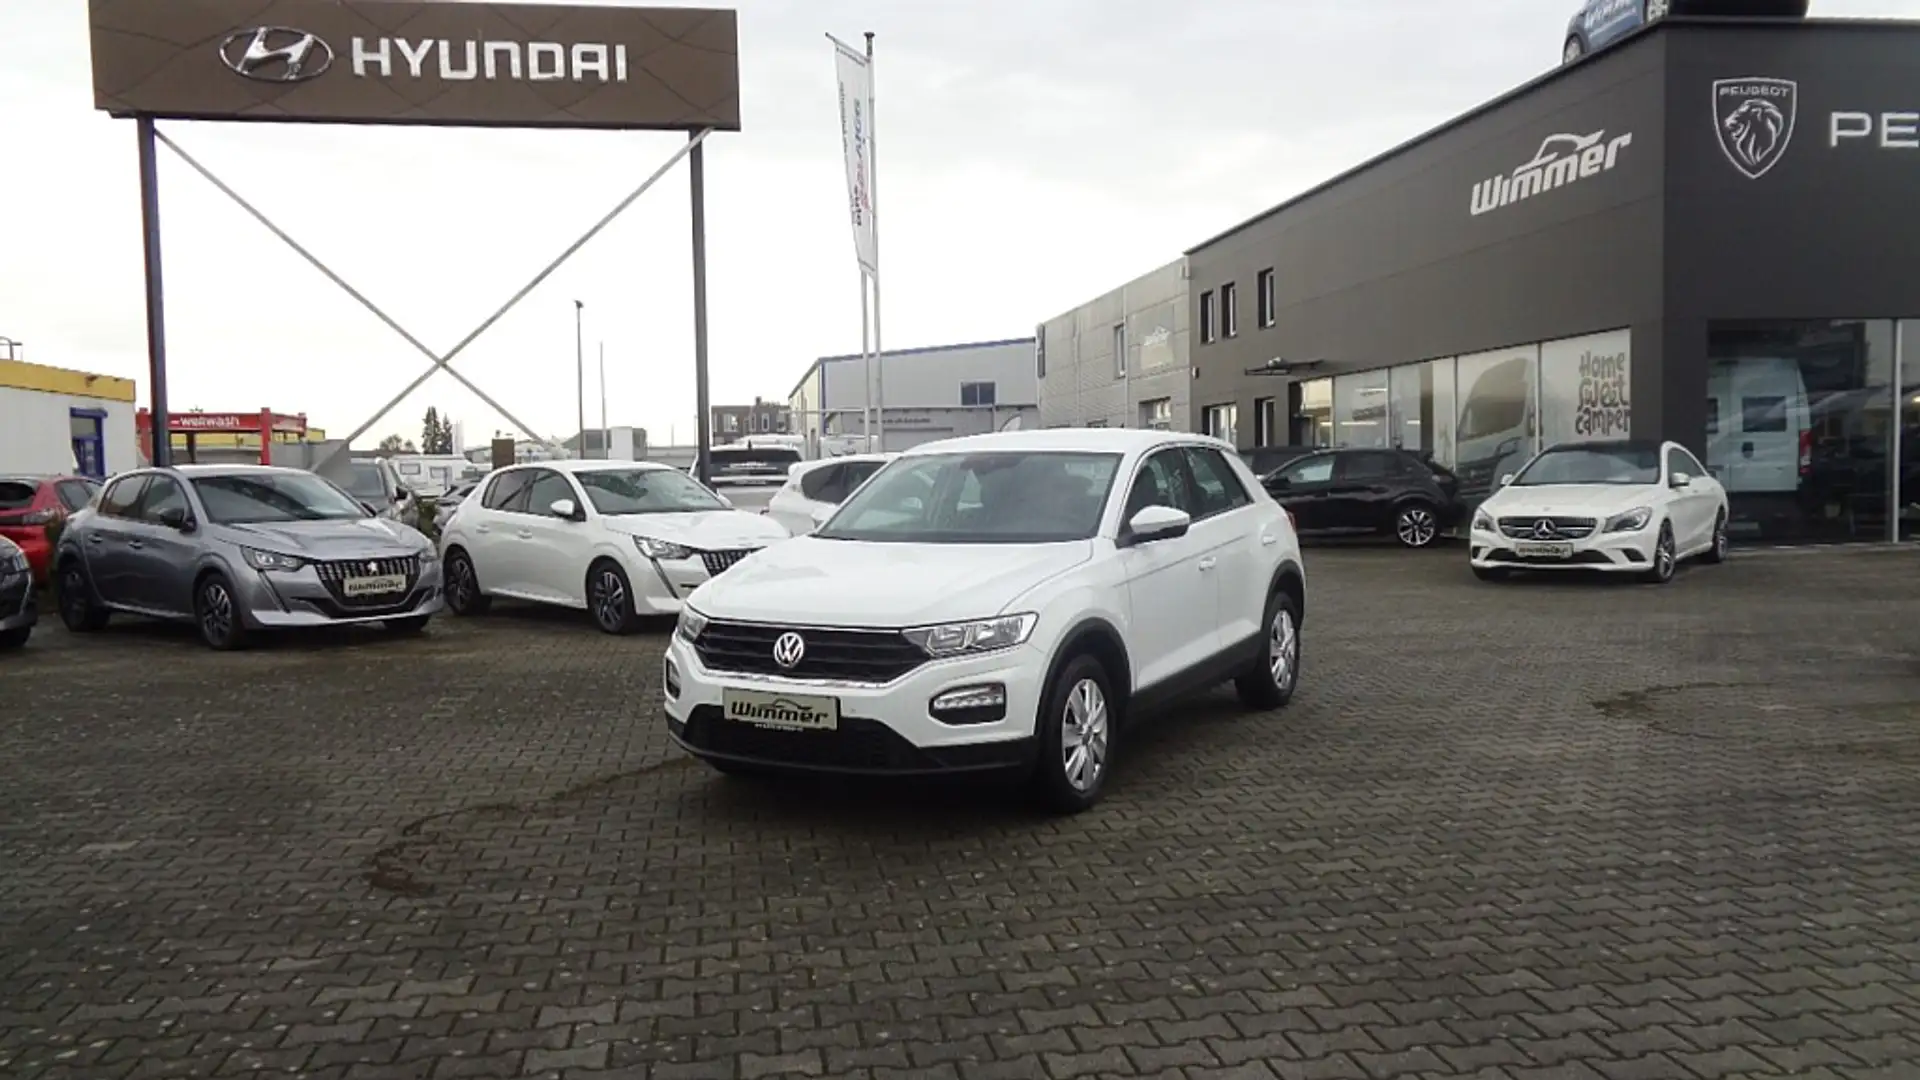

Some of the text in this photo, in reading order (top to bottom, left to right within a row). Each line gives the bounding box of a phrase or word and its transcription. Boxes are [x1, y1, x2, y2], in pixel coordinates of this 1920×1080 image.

[352, 36, 627, 81] HYUNDAI
[1719, 86, 1791, 97] PEUGEOT
[1470, 132, 1632, 216] Wimmer
[1578, 350, 1625, 379] Home
[731, 701, 829, 724] Wimmer
